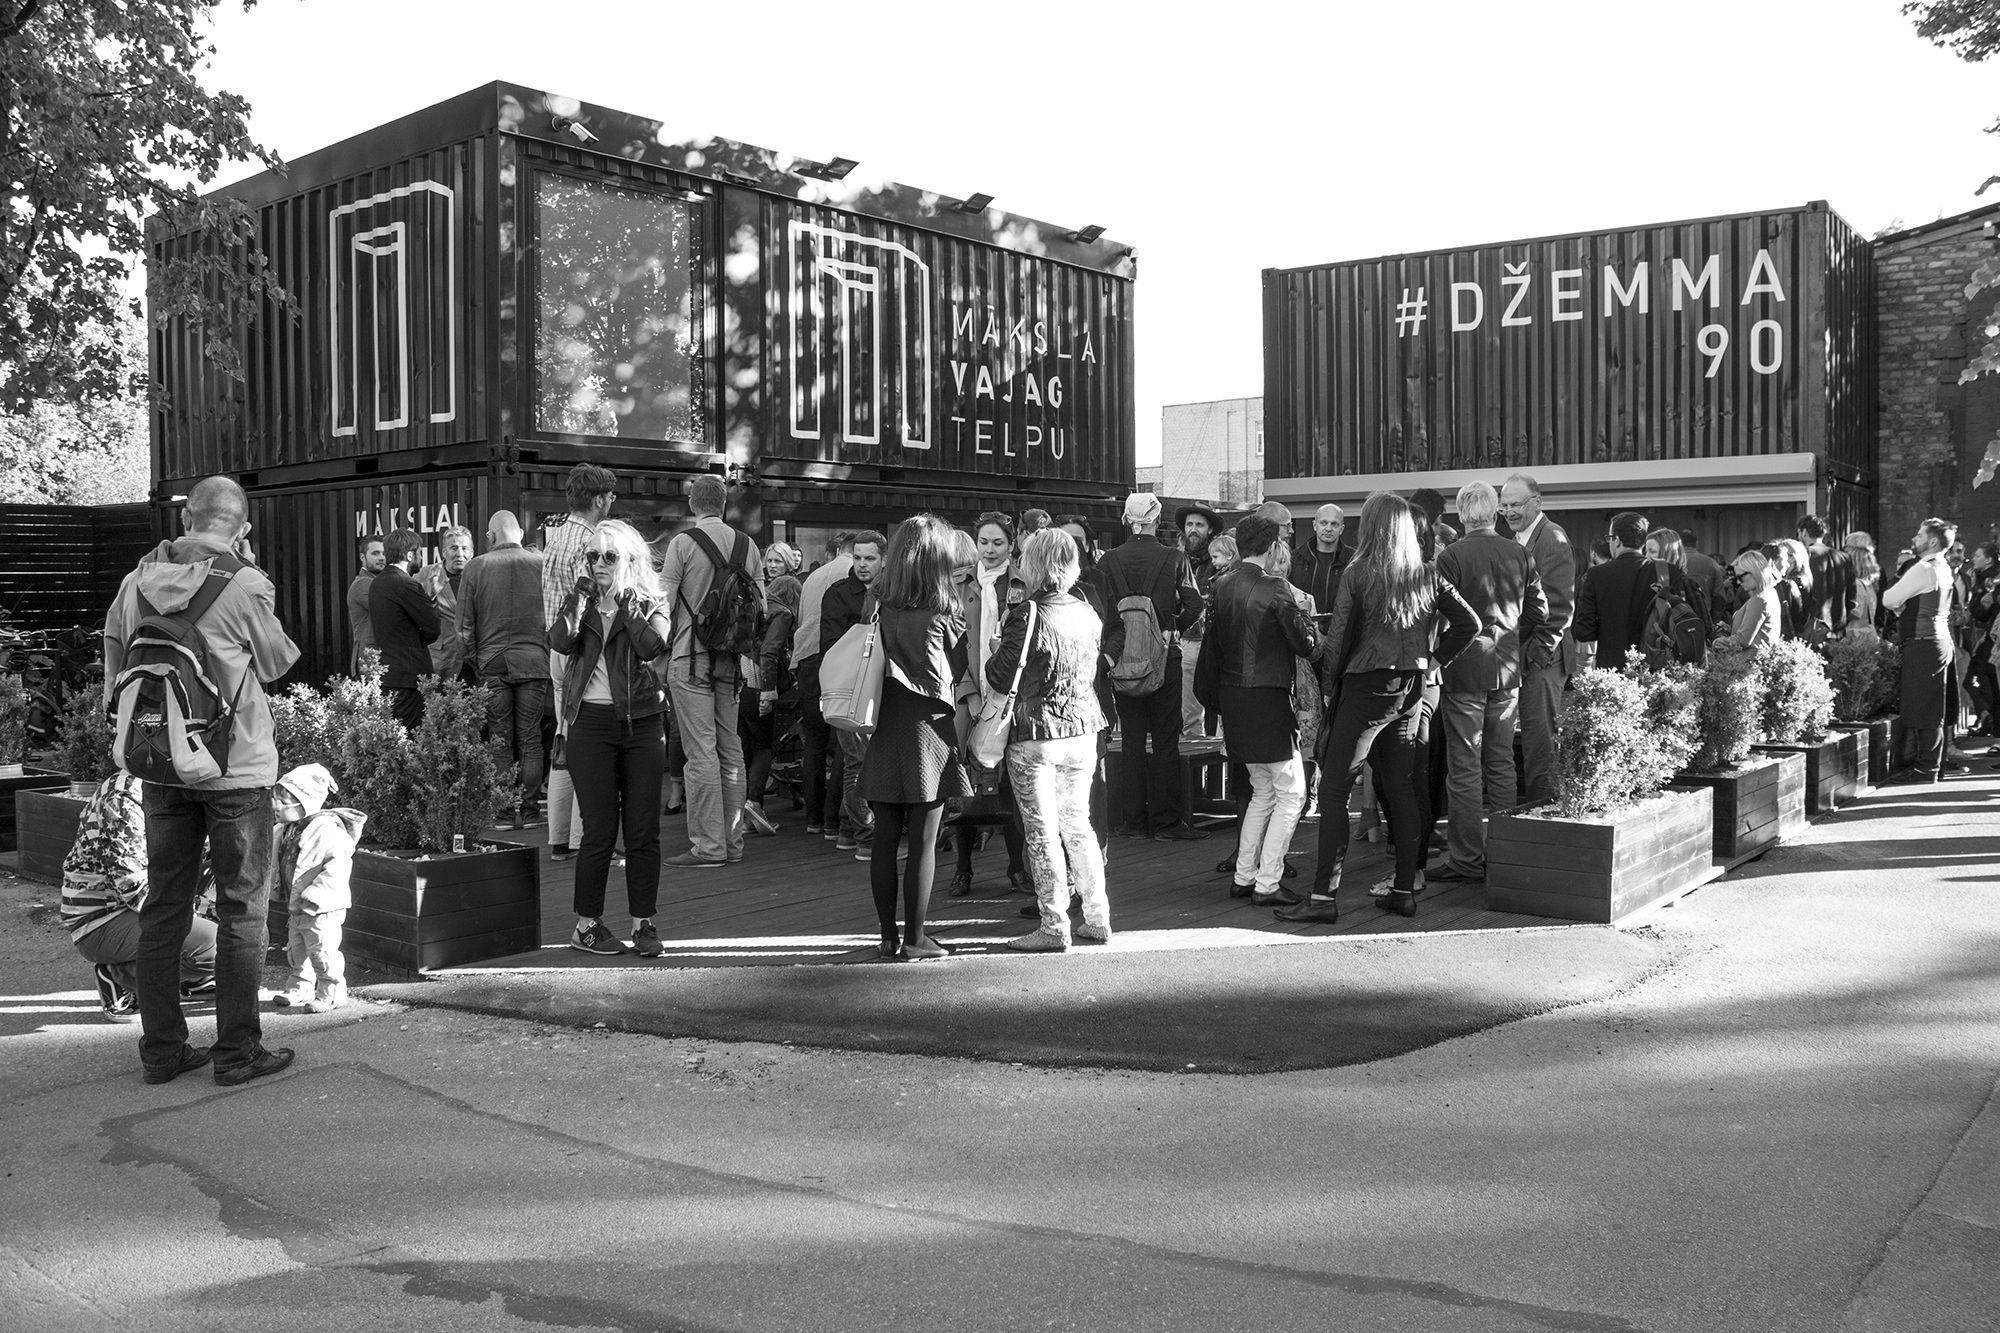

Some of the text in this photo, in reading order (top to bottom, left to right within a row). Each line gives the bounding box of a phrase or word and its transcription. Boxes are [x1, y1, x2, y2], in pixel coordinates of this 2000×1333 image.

[1696, 318, 1783, 378] 90
[950, 360, 1063, 409] VAJAG
[951, 416, 1064, 460] TELPU
